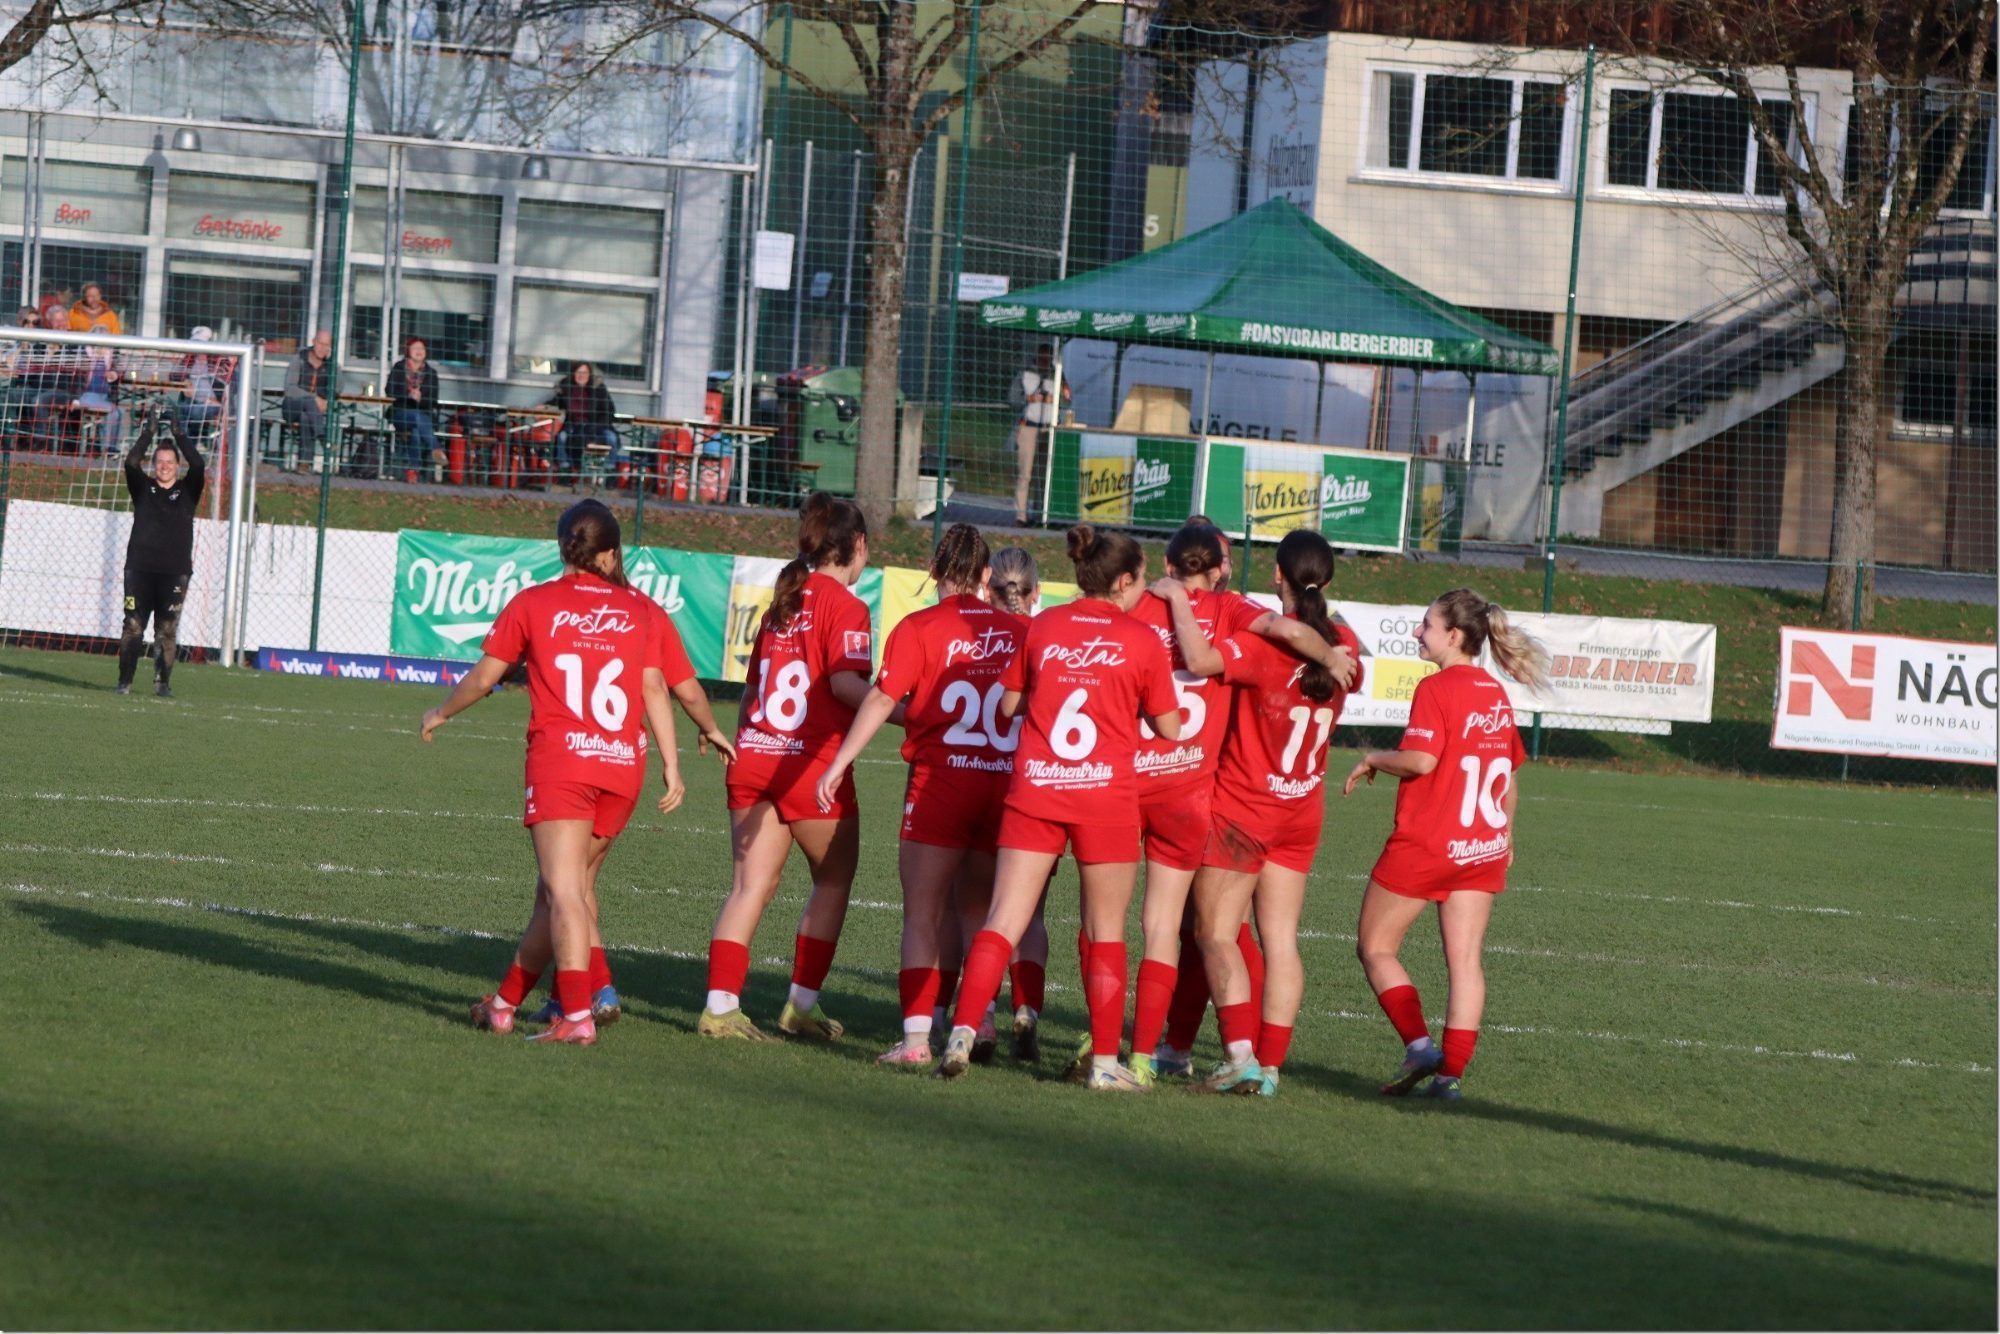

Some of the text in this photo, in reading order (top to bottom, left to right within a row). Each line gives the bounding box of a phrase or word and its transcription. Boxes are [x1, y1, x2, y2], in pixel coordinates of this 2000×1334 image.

[60, 203, 92, 221] Bon
[199, 214, 283, 238] Getränke
[1143, 214, 1159, 236] 5
[402, 230, 452, 250] Essen
[1240, 322, 1434, 358] #DASVORARLBERGERBIER
[1080, 457, 1171, 498] Mohrenbräu
[1245, 473, 1372, 512] Mohrenbräu
[551, 604, 635, 638] postai
[1380, 615, 1423, 635] GÖT
[573, 641, 616, 652] SKIN CARE
[946, 627, 1016, 667] postai
[1040, 636, 1126, 671] postai
[1378, 638, 1421, 656] KOB
[1578, 642, 1662, 660] Firmengruppe
[281, 658, 322, 675] vkw
[339, 661, 380, 679] vkw
[396, 665, 437, 683] vkw
[967, 668, 985, 676] SKIN
[1058, 676, 1101, 686] SKIN CARE
[1550, 654, 1698, 686] BRANNER
[1898, 653, 1997, 709] NÄG
[555, 653, 628, 732] 16
[750, 658, 810, 731] 18
[1386, 687, 1413, 700] SPE
[940, 680, 1024, 752] 20
[1050, 688, 1097, 760] 6
[1896, 714, 1981, 730] WOHNBAU
[1281, 706, 1334, 775] 11
[1025, 760, 1113, 780] Mohrenbräu
[1460, 755, 1513, 829] 10
